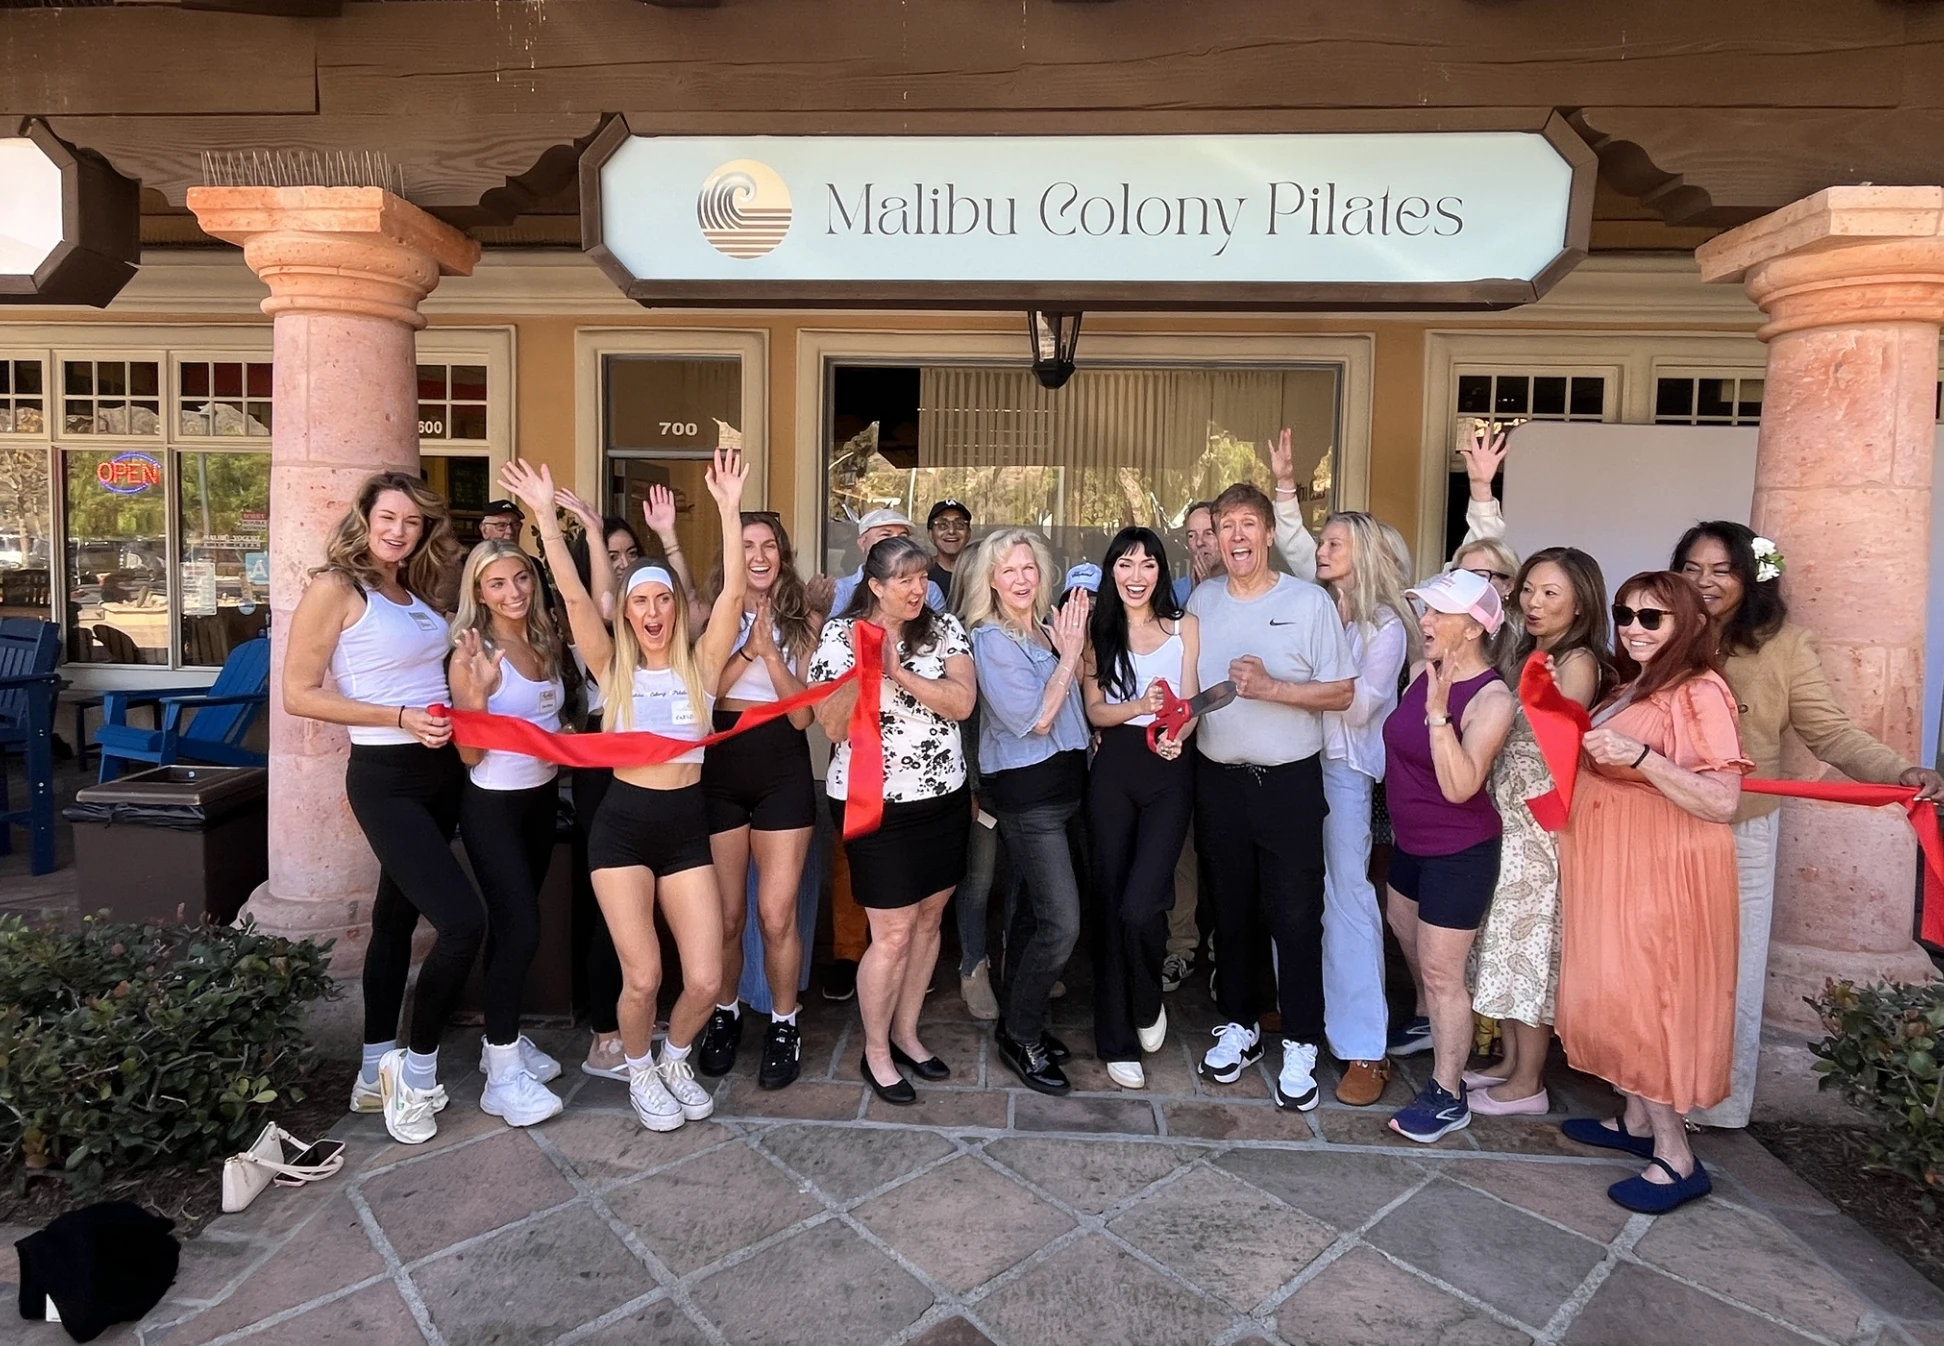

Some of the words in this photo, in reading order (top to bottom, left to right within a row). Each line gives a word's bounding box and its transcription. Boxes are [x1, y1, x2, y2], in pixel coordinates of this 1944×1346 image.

[825, 181, 1019, 237] Malibu
[1038, 180, 1249, 257] Colony
[1265, 180, 1465, 237] Pilates
[418, 420, 443, 434] 600
[658, 422, 698, 436] 700
[97, 461, 160, 484] OPEN
[251, 559, 267, 578] A
